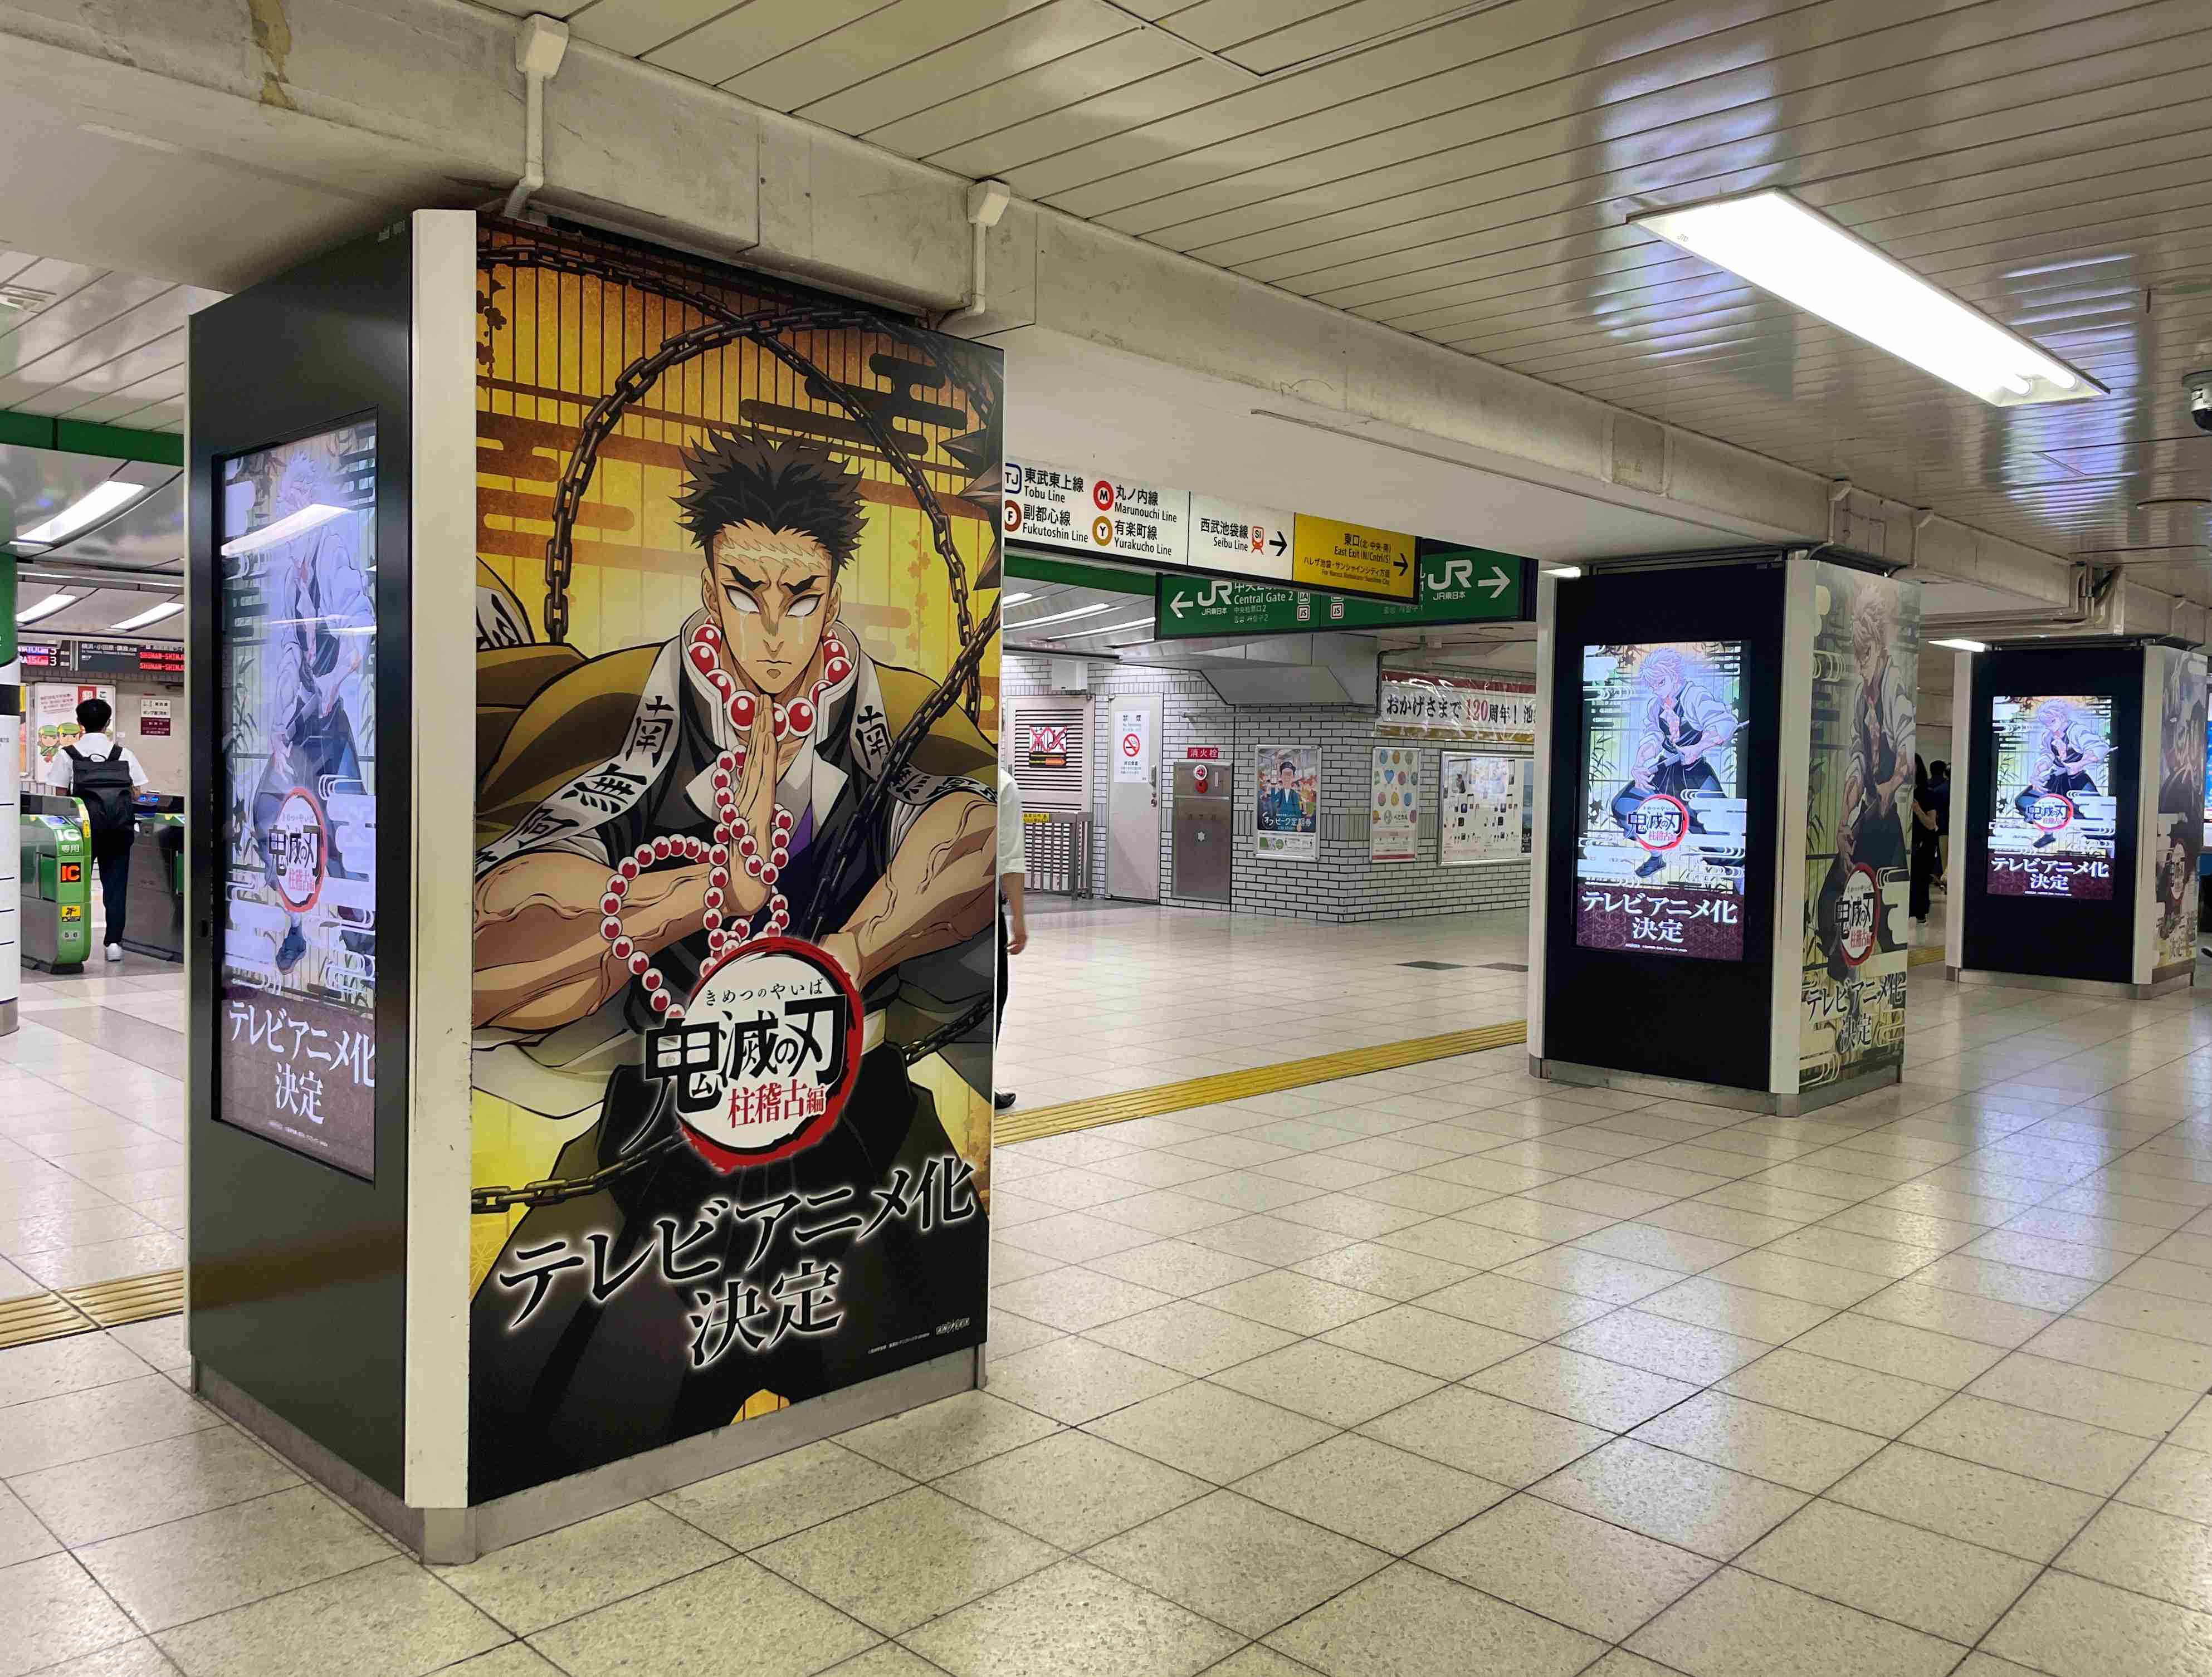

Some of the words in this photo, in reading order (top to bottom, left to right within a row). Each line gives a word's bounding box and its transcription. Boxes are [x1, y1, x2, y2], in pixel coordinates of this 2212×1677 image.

[1005, 472, 1019, 485] TJ
[1024, 467, 1085, 493] 東武東上線
[1024, 485, 1046, 500] Tobu
[1048, 488, 1066, 503] Line
[1100, 490, 1109, 501] M
[1115, 485, 1159, 506] 丸ノ内線
[1007, 511, 1013, 521] F
[1023, 503, 1071, 527] 副都心線
[1115, 502, 1160, 520] Marunouchi
[1162, 510, 1178, 523] Line
[1023, 522, 1070, 541] Fukutoshin
[1071, 530, 1089, 544] Line
[1099, 526, 1107, 537] Y
[1115, 520, 1158, 541] 有楽町線
[1200, 517, 1248, 539] 西武池袋線
[1114, 537, 1155, 554] Yurakucho
[1156, 543, 1172, 556] Line
[1213, 536, 1232, 550] Seibu
[1234, 539, 1248, 553] Line
[1334, 545, 1347, 556] East
[1349, 548, 1360, 558] Exit
[1428, 559, 1473, 590] JR
[1198, 580, 1233, 607] JR
[1234, 592, 1263, 604] Central
[1266, 592, 1286, 603] Gate
[1288, 591, 1293, 601] 2
[1432, 591, 1466, 601] JR東日本
[1201, 607, 1228, 615] JR東日本
[1190, 748, 1219, 757] 消火栓
[56, 829, 81, 842] IC
[61, 865, 80, 881] IC
[1991, 858, 2110, 878] テレビアニメ化
[2029, 873, 2069, 891] 決定
[1581, 891, 1739, 925] テレビアニメ化
[1632, 916, 1684, 943] 決定
[705, 978, 824, 1006] きめつのやいば
[1806, 972, 1906, 1021] テレビアニメ化
[228, 1001, 375, 1088] テレビアニメ化
[622, 994, 847, 1151] 鬼滅の刃
[276, 1061, 324, 1124] 決定
[727, 1078, 827, 1129] 柱稽古編
[500, 1157, 976, 1329] テレビアニメ化
[691, 1261, 842, 1367] 決定
